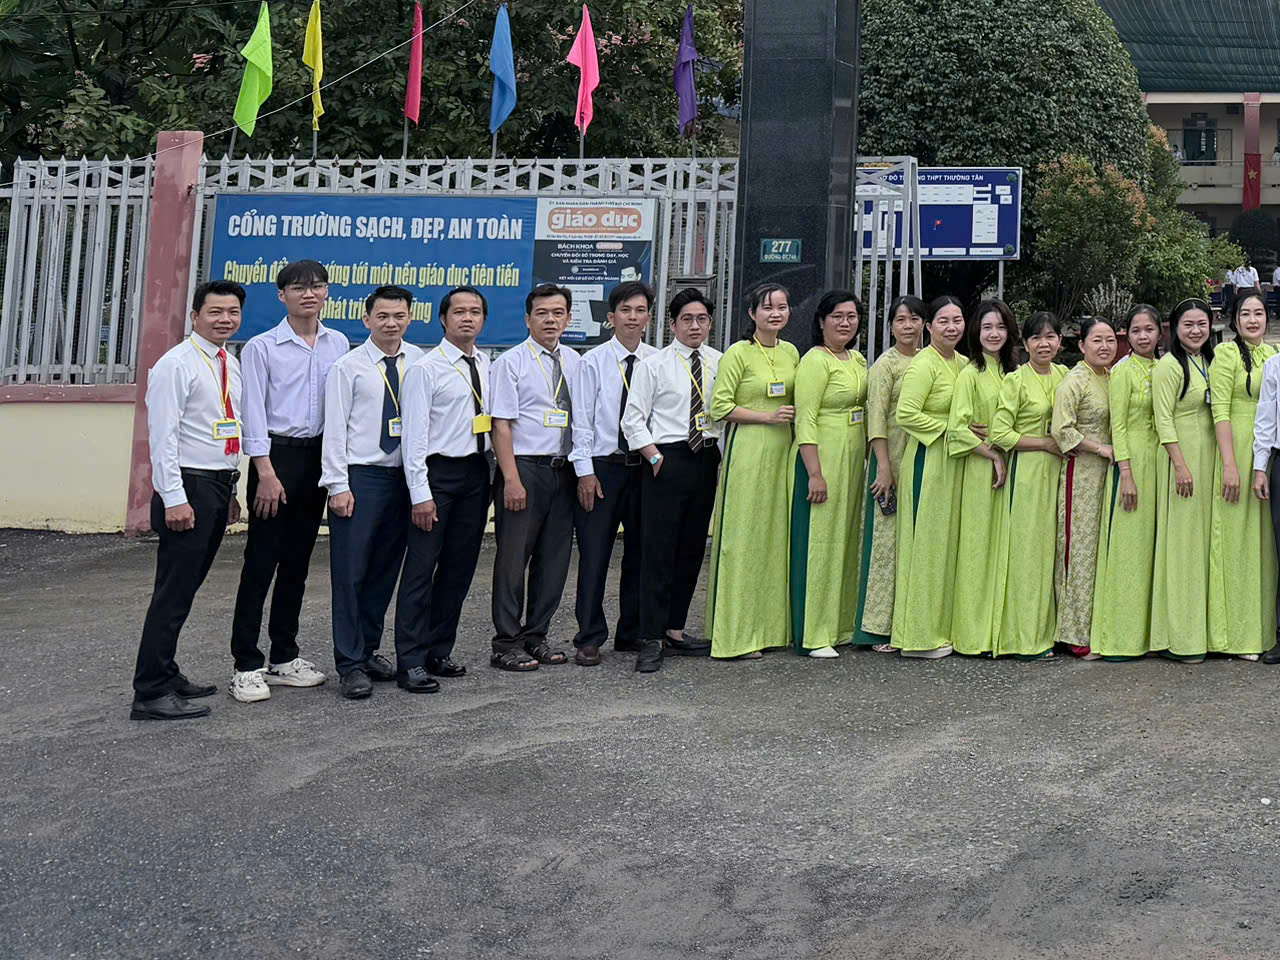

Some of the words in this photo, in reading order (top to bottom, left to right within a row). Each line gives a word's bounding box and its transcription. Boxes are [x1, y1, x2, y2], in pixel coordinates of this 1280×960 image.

[971, 173, 984, 181] TÂN
[228, 208, 278, 237] CỔNG
[281, 211, 352, 238] TRƯỜNG
[355, 215, 407, 243] SẠCH,
[410, 216, 445, 243] ĐẸP,
[447, 218, 473, 239] AN
[476, 214, 523, 240] TOÀN
[551, 208, 598, 230] giáo
[601, 210, 639, 230] dục
[771, 240, 792, 253] 277
[224, 256, 267, 285] Chuyển
[352, 260, 368, 284] tới
[369, 262, 393, 286] một
[394, 261, 418, 285] nền
[418, 262, 445, 288] giáo
[446, 263, 470, 288] dục
[471, 263, 495, 286] tiên
[496, 262, 520, 287] tiến
[321, 295, 347, 320] phát
